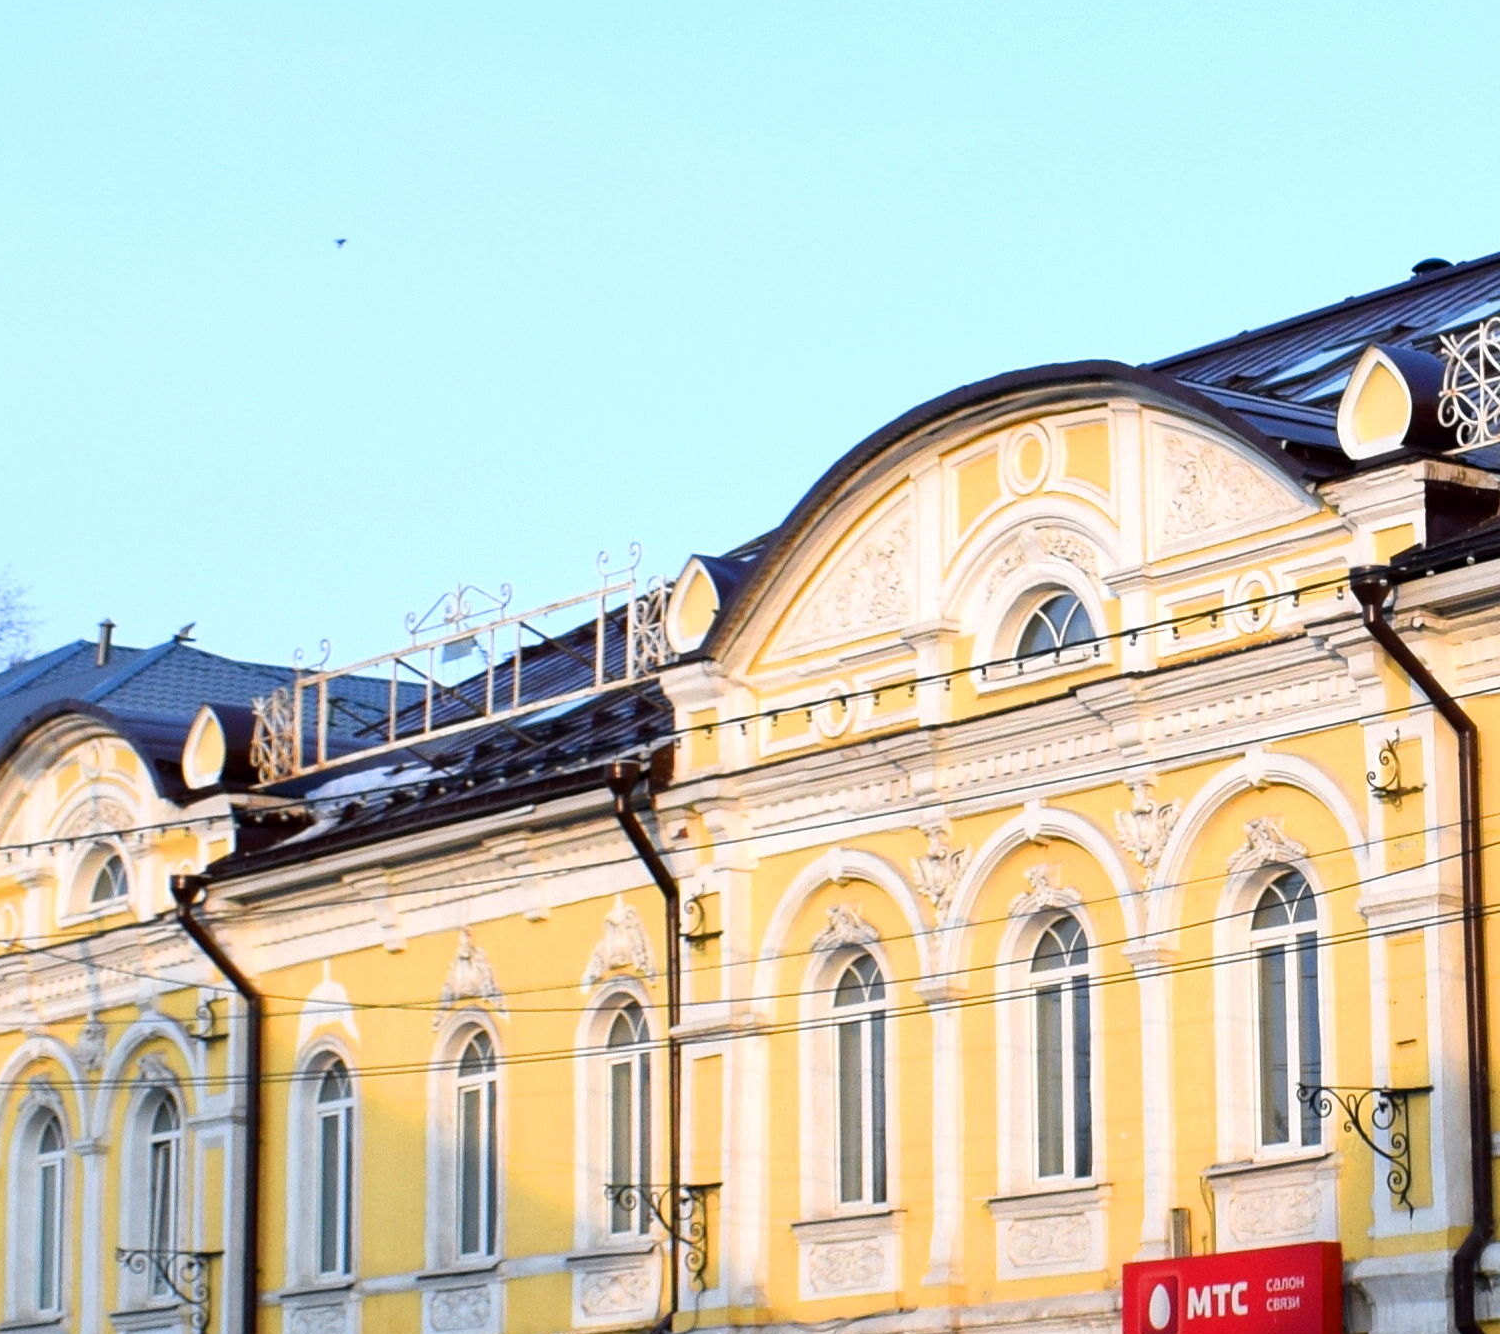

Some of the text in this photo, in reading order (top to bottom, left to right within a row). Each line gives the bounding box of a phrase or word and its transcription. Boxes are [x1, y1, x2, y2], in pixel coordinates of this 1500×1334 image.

[1266, 1276, 1305, 1292] салон
[1187, 1281, 1248, 1320] МТС
[1266, 1296, 1301, 1312] связи
